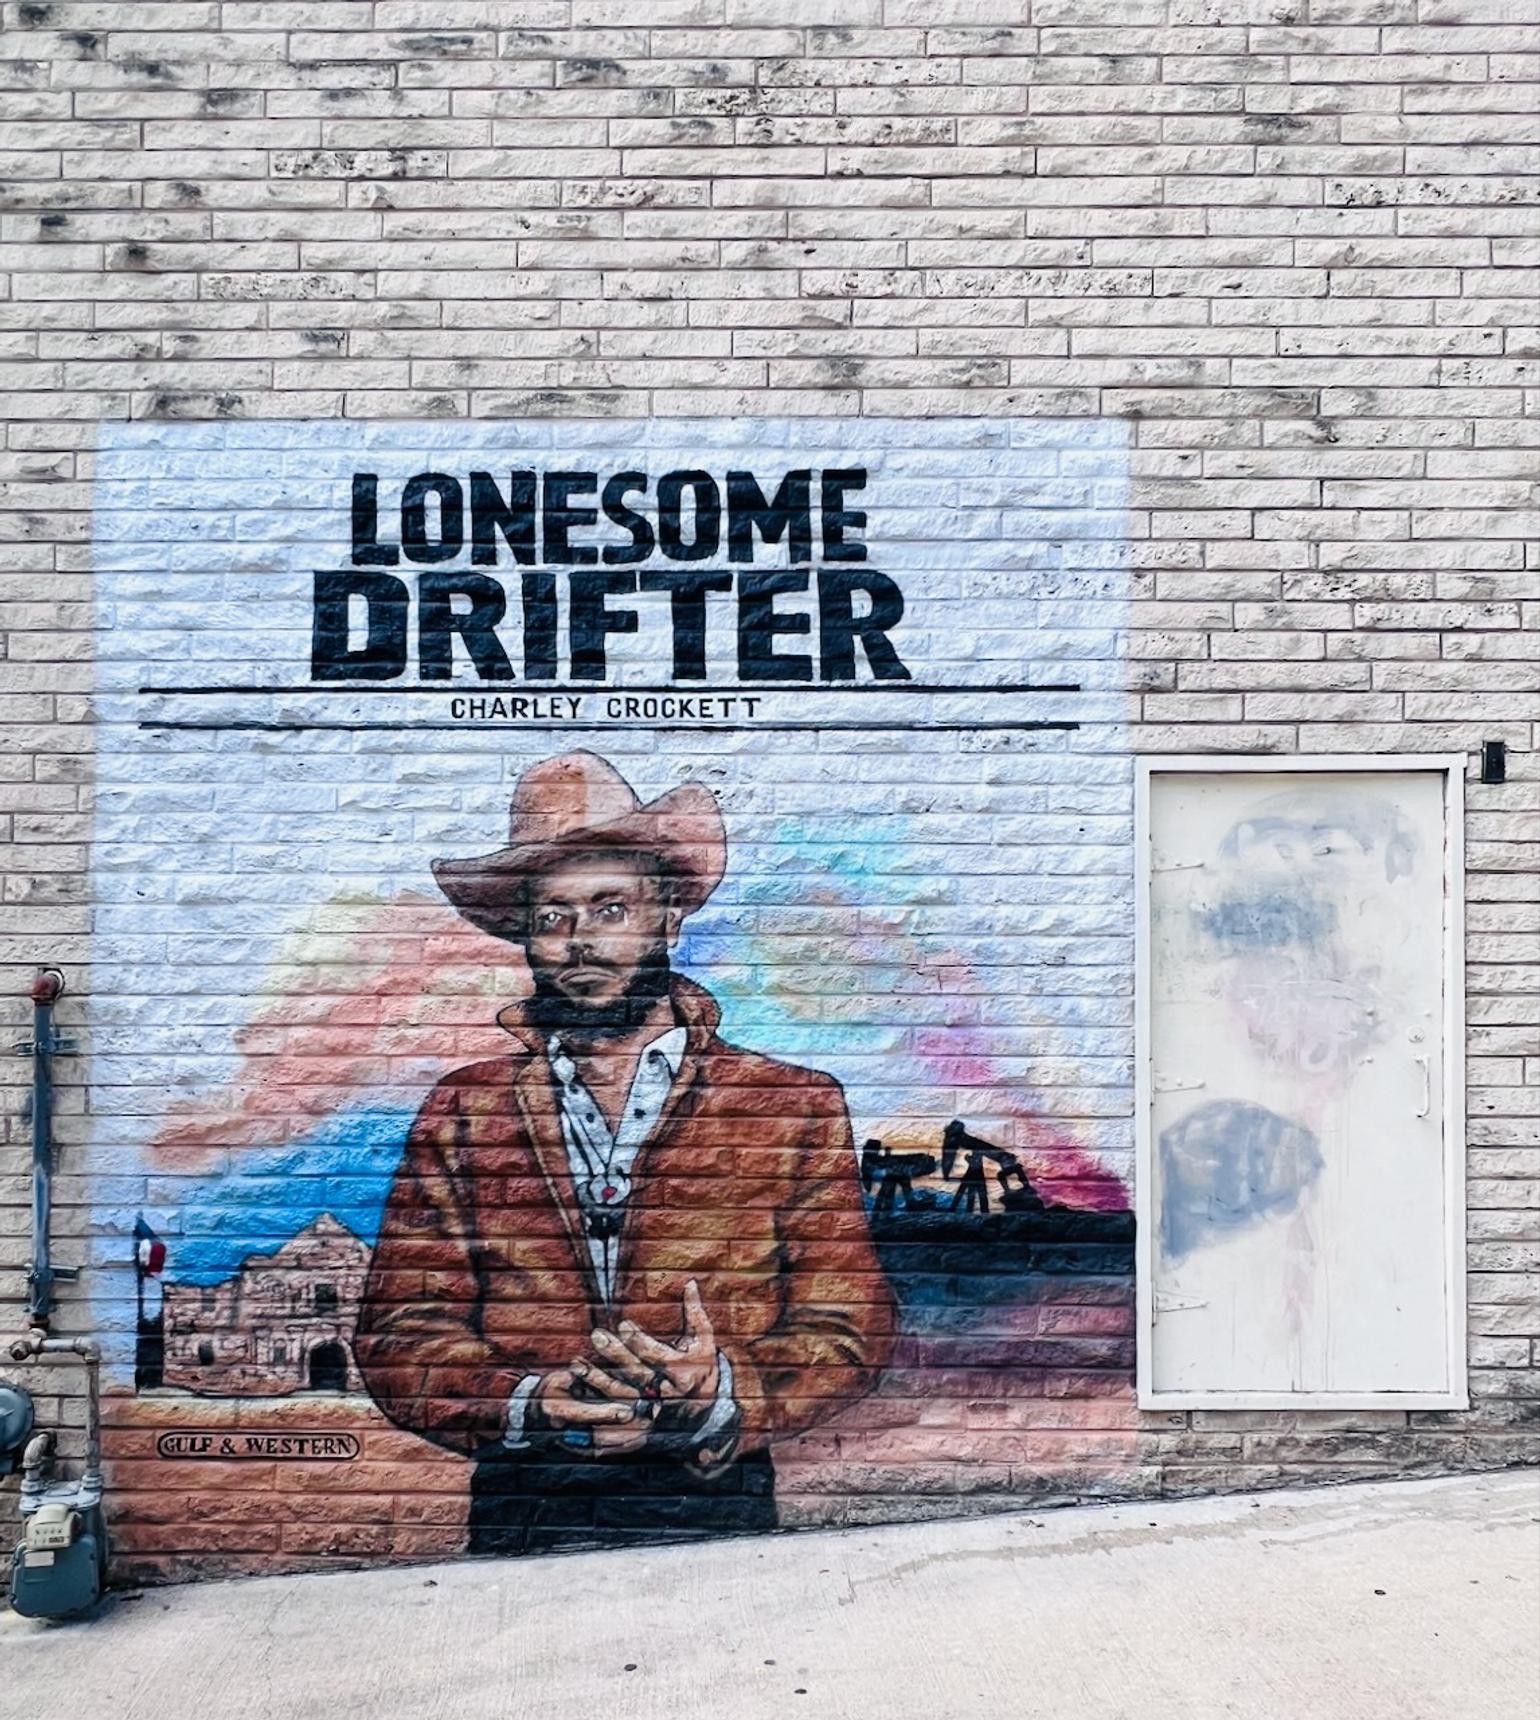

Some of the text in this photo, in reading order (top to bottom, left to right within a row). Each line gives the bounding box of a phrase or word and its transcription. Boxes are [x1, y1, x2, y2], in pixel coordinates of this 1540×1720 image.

[351, 469, 867, 566] LONESOME
[311, 570, 911, 681] DRIFTER
[451, 697, 761, 719] CHARLEY CROCKETT
[164, 1437, 351, 1455] GULF & WESTERN
